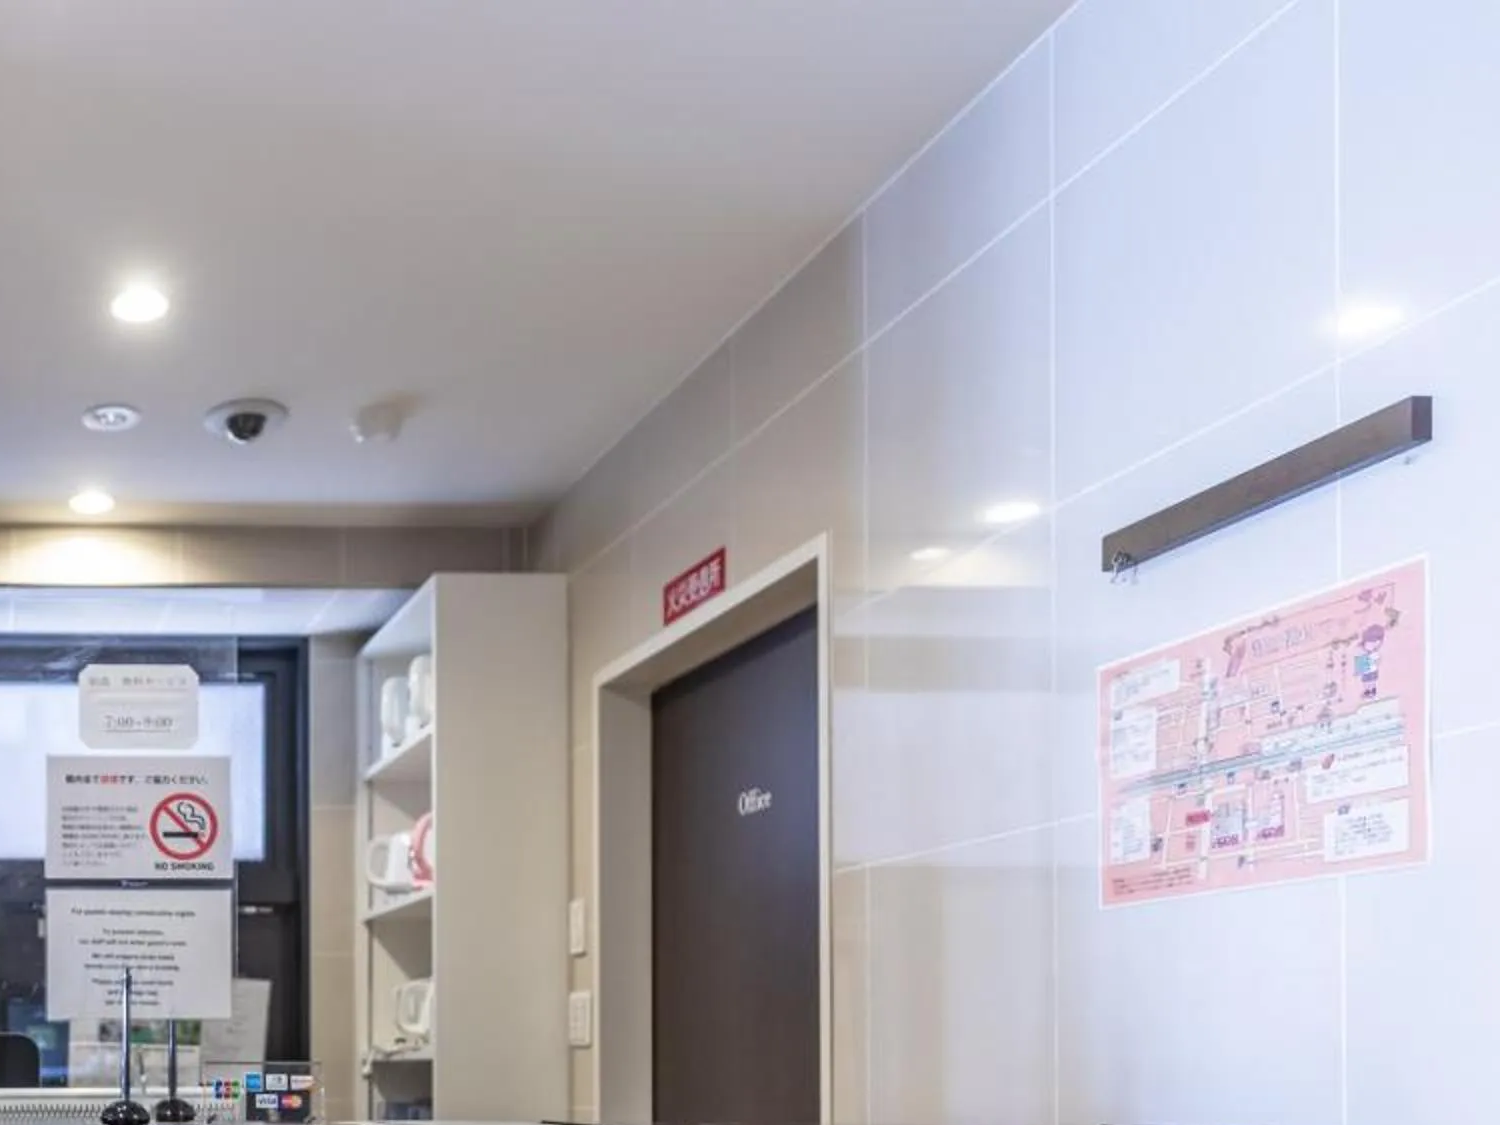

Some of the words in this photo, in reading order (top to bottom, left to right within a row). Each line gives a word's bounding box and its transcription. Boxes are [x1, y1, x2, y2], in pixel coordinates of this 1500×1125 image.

[737, 787, 773, 816] Office
[154, 861, 169, 871] NO
[170, 861, 215, 872] SMOKING
